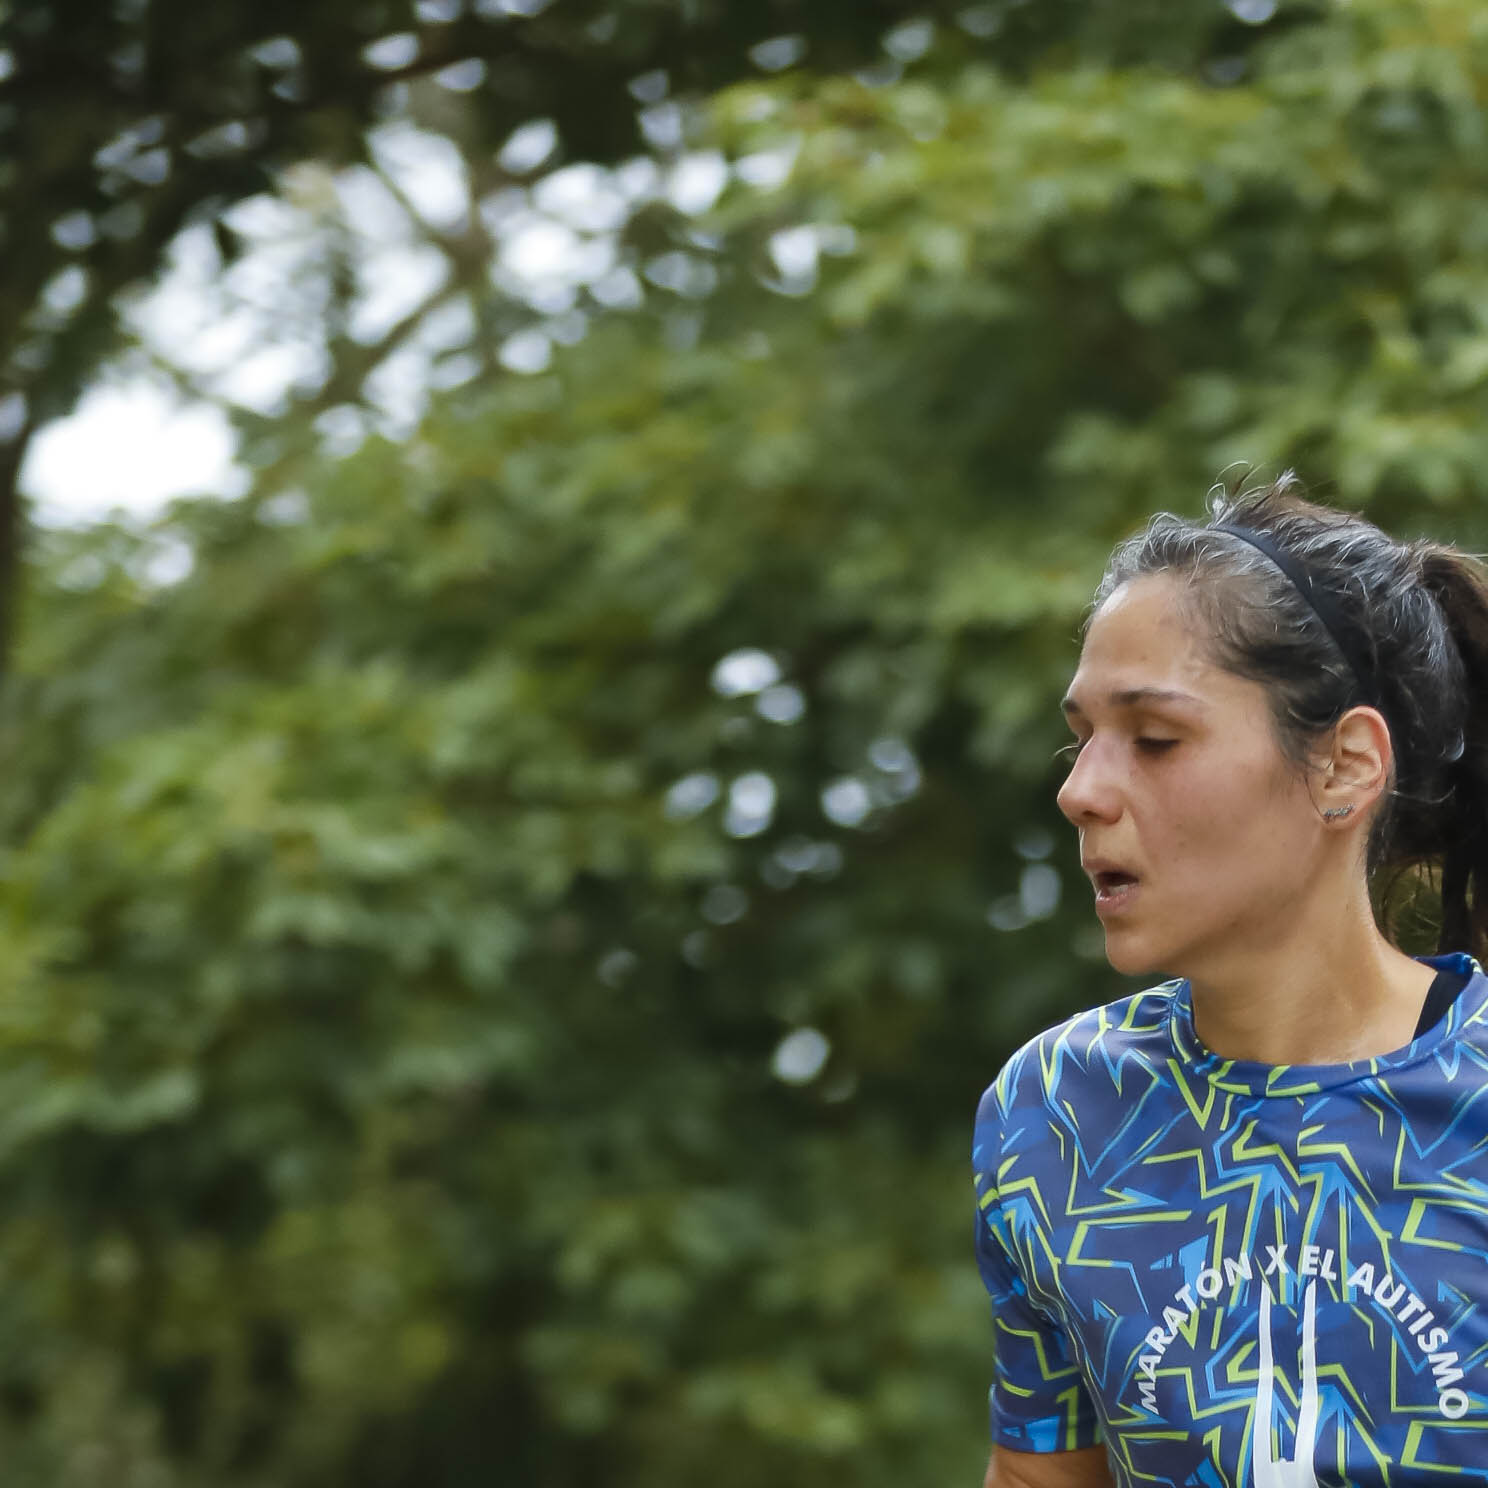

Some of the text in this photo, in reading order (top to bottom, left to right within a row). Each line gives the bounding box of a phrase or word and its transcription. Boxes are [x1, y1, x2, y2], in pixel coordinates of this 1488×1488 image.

[1138, 1243, 1471, 1420] MARATÓN X EL AUTISMO
